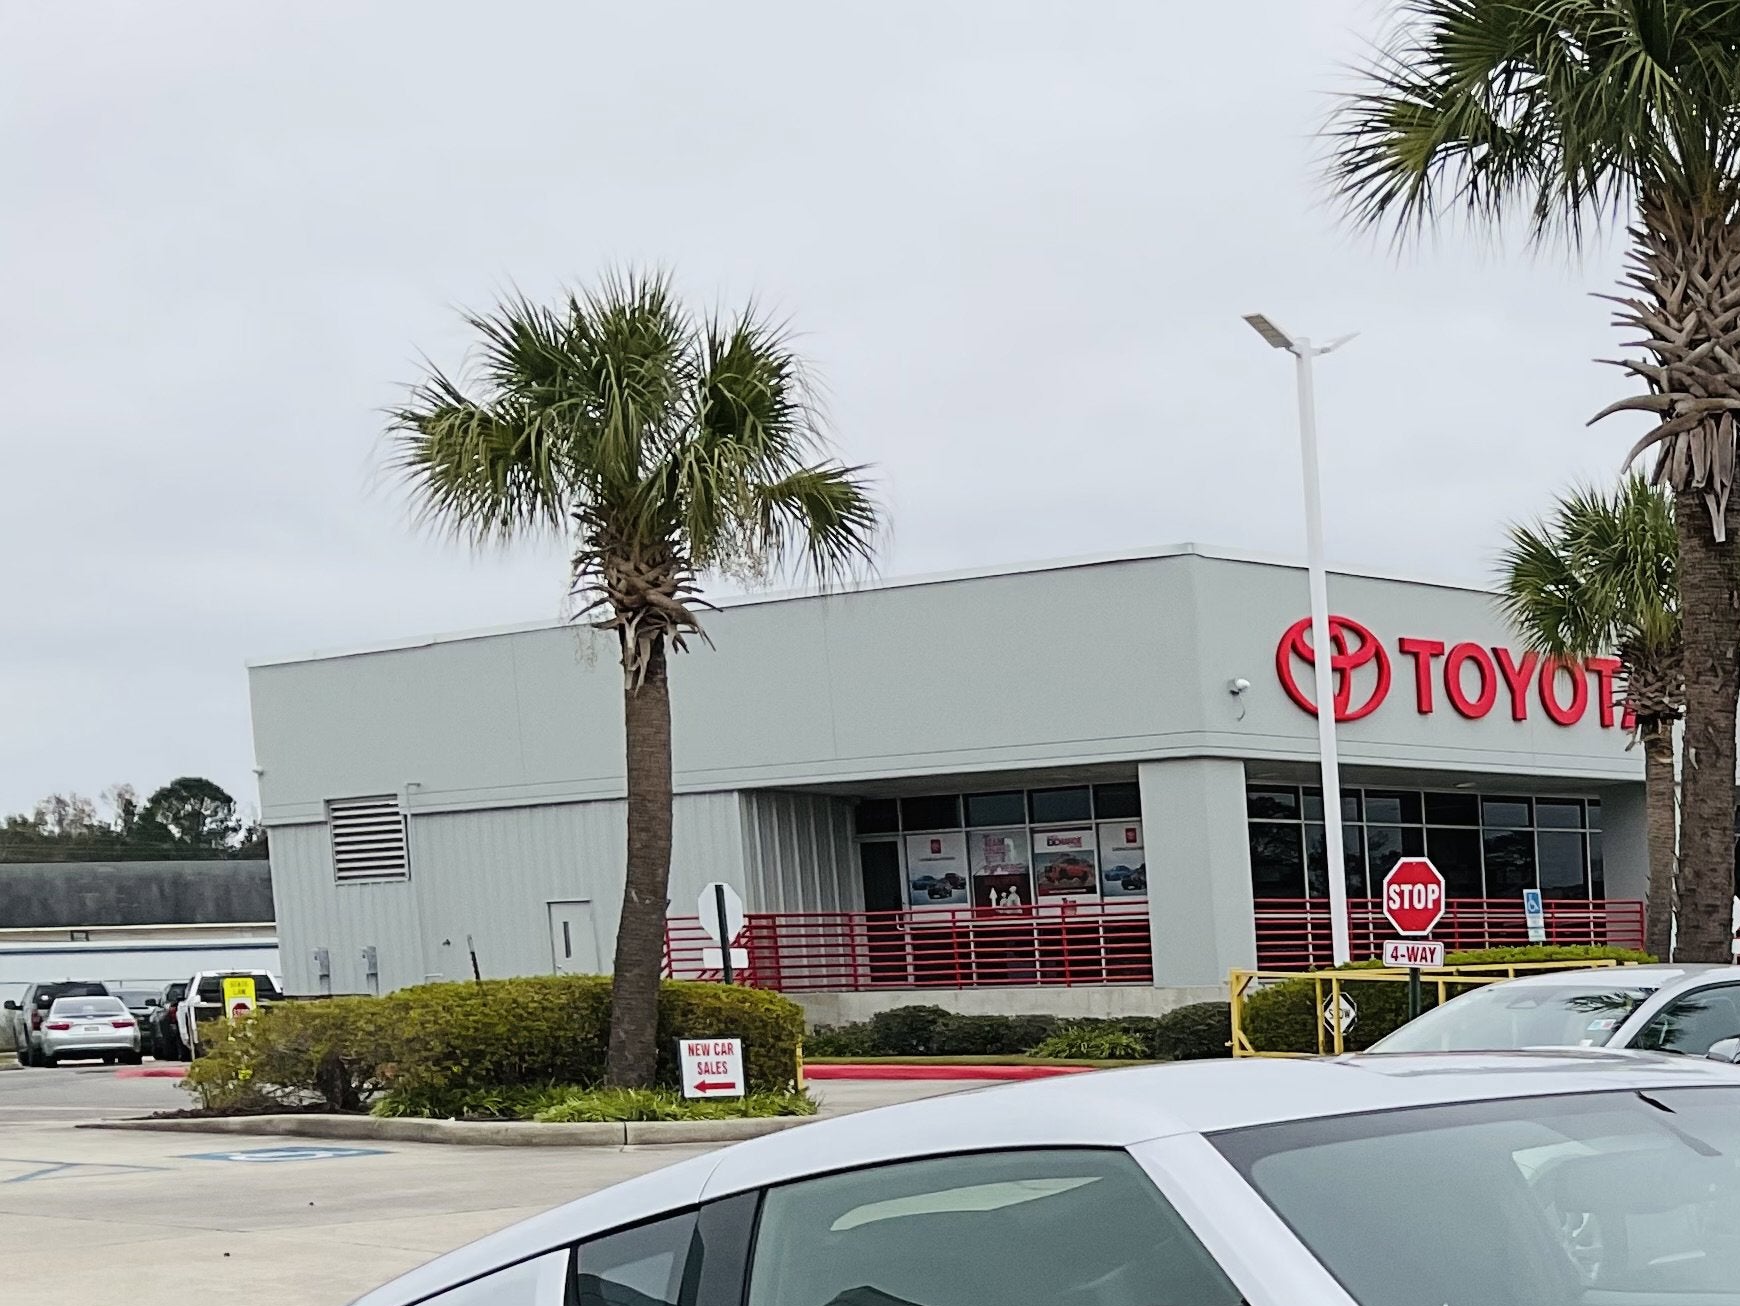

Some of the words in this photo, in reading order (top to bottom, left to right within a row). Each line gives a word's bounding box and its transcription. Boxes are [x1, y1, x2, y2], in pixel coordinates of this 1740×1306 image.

[1388, 884, 1440, 910] STOP
[1391, 945, 1437, 963] 4-WAY
[1328, 1008, 1351, 1019] SOW
[688, 1043, 710, 1056] NEW
[714, 1042, 734, 1056] CAR
[697, 1061, 728, 1075] SALES
